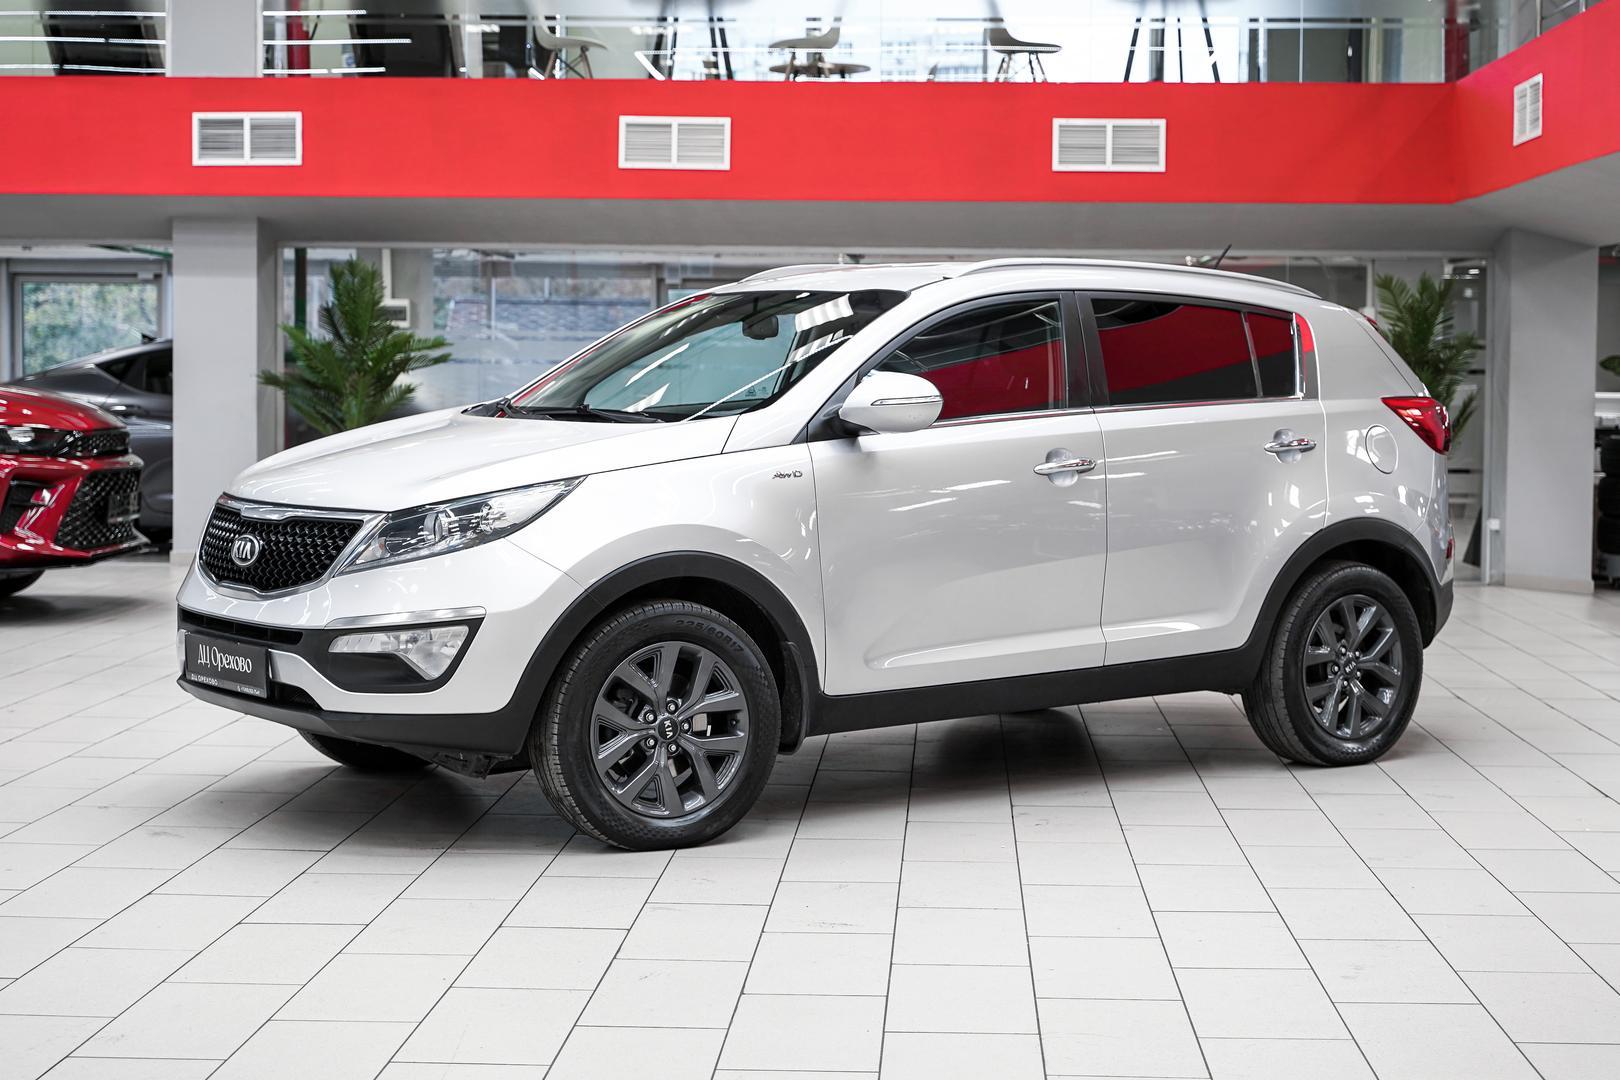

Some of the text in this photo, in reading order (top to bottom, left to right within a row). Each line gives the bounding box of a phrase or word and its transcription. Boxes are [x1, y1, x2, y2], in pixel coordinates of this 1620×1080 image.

[232, 540, 252, 560] KIA
[198, 643, 253, 674] ДЦ Орехово
[663, 719, 674, 739] KIA
